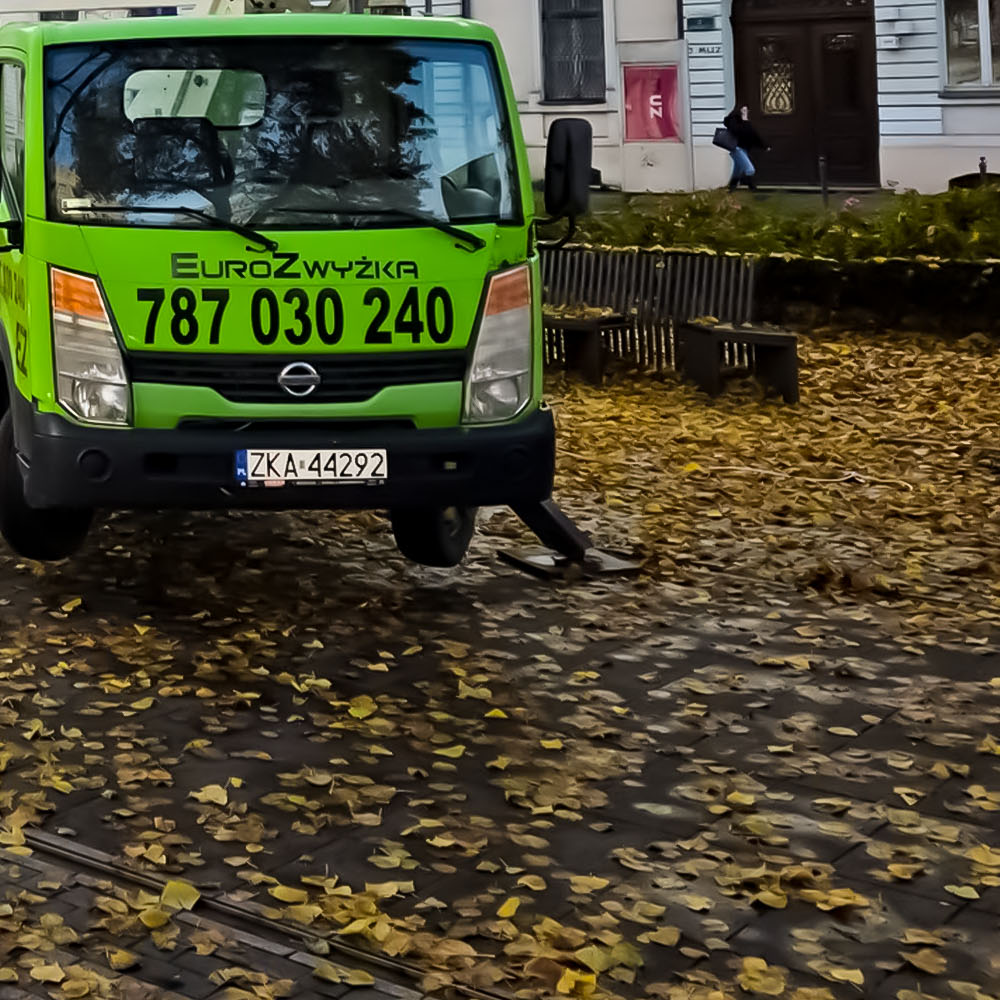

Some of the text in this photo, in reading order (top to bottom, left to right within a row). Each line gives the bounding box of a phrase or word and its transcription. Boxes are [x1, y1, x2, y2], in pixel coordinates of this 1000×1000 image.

[136, 285, 455, 346] 787 030 240
